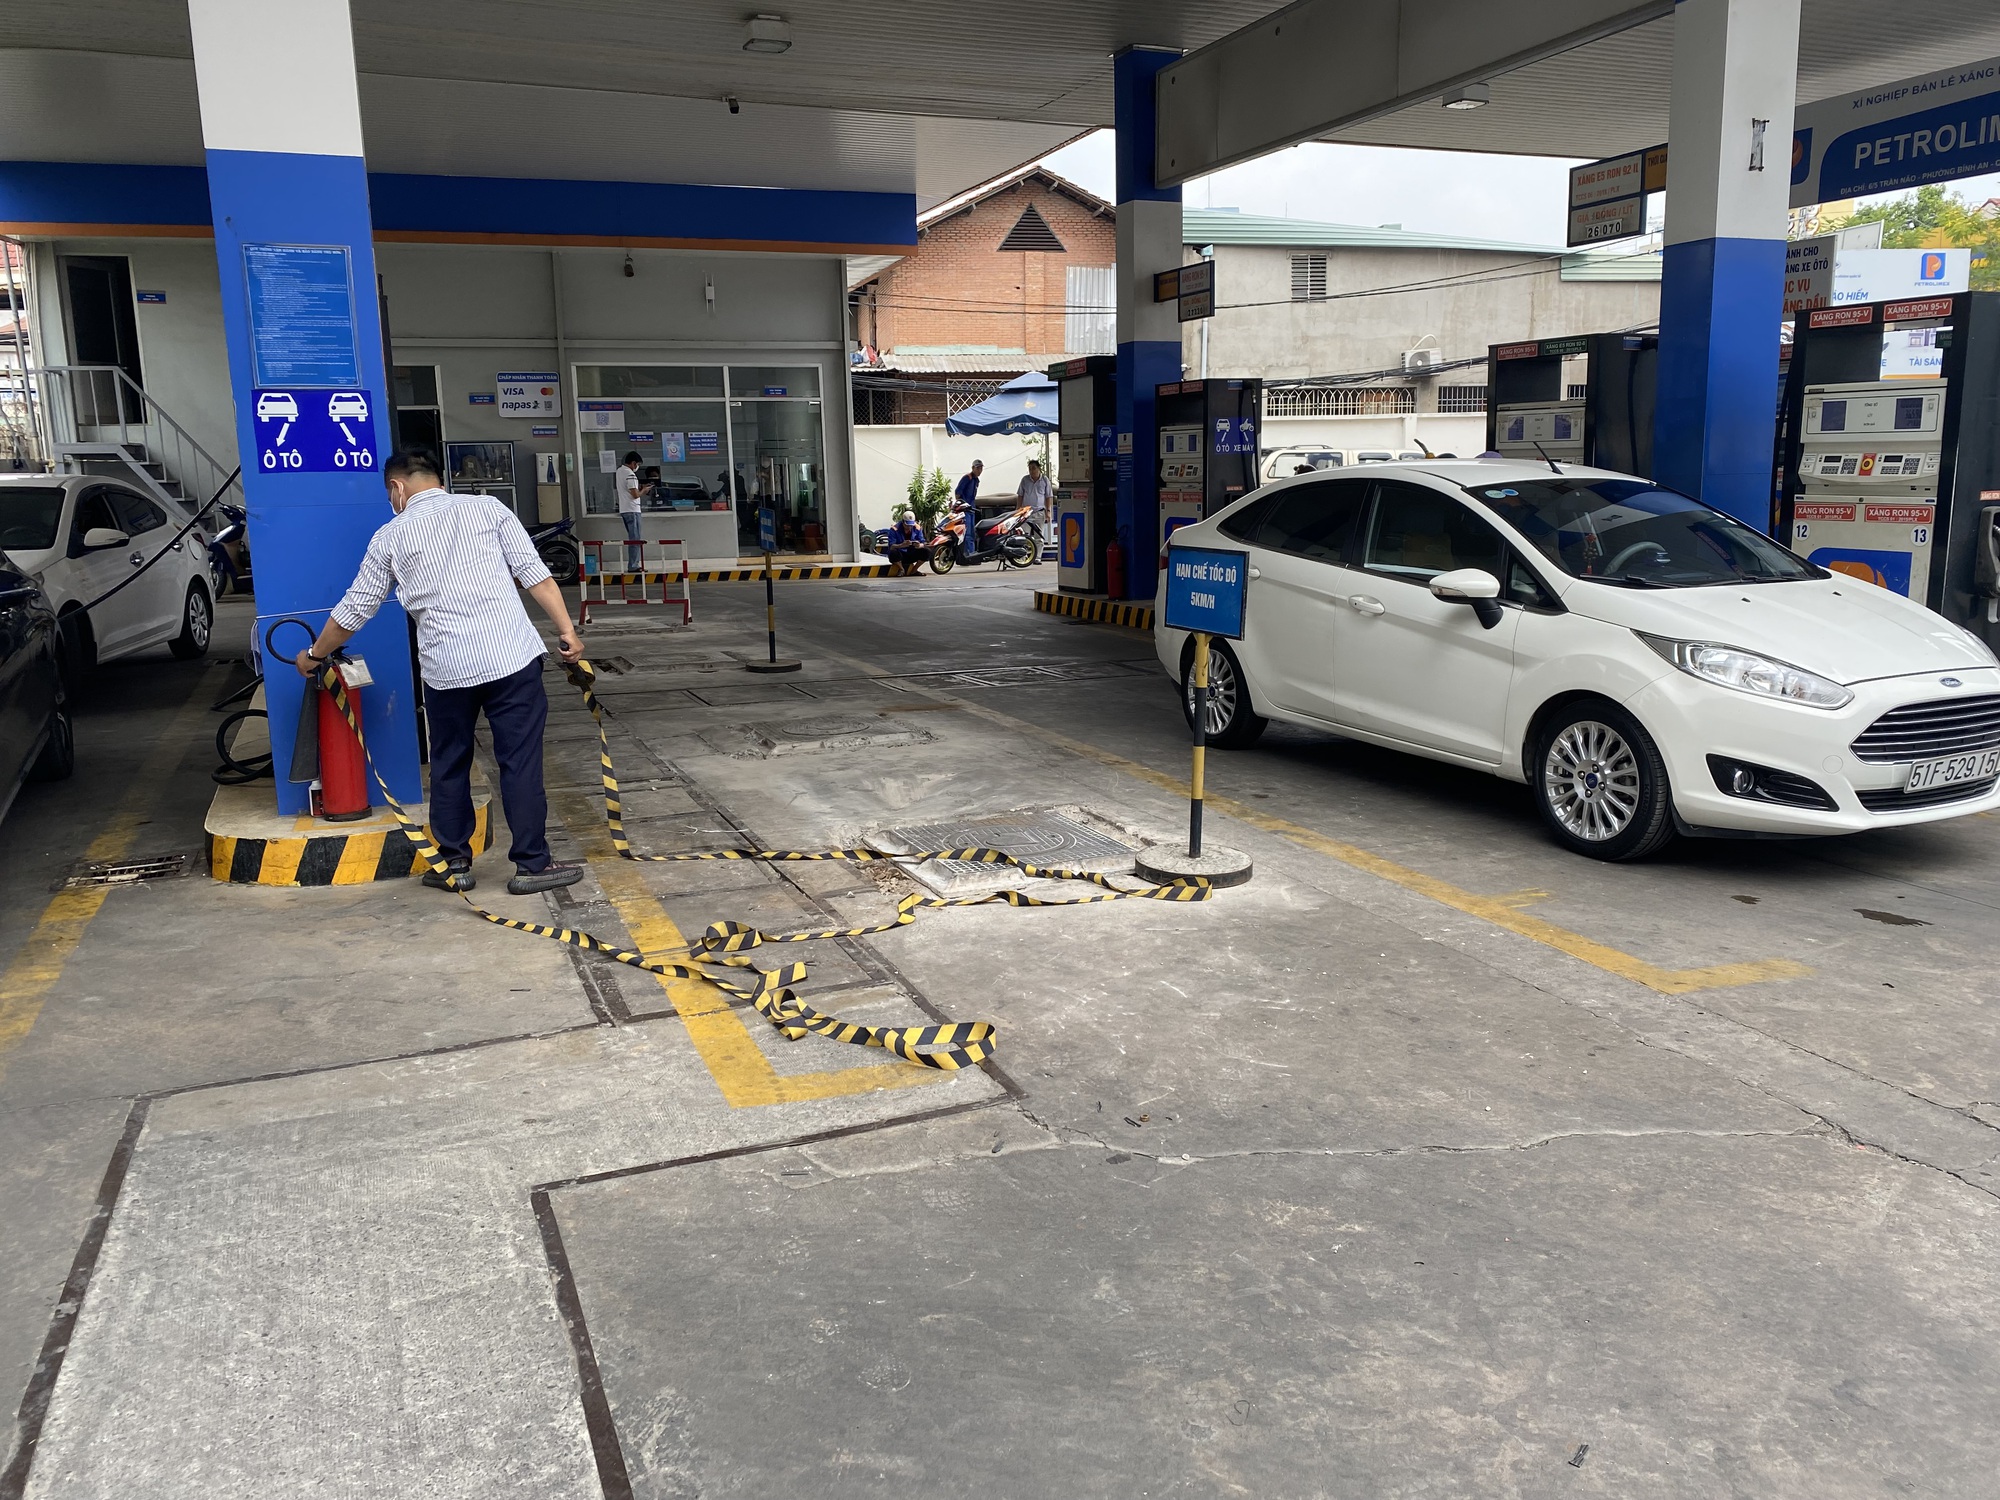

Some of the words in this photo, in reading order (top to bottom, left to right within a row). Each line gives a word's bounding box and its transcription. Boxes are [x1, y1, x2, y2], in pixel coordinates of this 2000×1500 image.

[1786, 248, 1801, 260] ÀNH
[1803, 246, 1819, 257] CHO
[1785, 262, 1800, 274] ÀNG
[1801, 262, 1811, 272] XE
[1797, 278, 1810, 294] VỤ
[1782, 298, 1803, 313] ĂNG
[1887, 305, 1910, 315] XĂNG
[1912, 303, 1929, 312] RON
[1931, 302, 1949, 311] 95-V
[1813, 312, 1834, 322] XĂNG
[1835, 311, 1851, 319] RON
[1852, 309, 1869, 318] 95-V
[502, 387, 524, 395] VISA
[1222, 444, 1230, 452] TÔ
[263, 449, 276, 469] Ô
[279, 448, 303, 468] TÔ
[334, 448, 347, 467] Ô
[350, 448, 373, 468] TÔ
[1798, 506, 1818, 514] XĂNG
[1869, 507, 1890, 516] XĂNG
[1911, 509, 1928, 517] 95-V
[1796, 525, 1808, 538] 12
[1914, 529, 1927, 543] 13
[1176, 563, 1191, 580] HẠN
[1192, 561, 1209, 580] CHẾ
[1209, 562, 1223, 582] TỐC
[1225, 565, 1236, 586] ĐỘ
[1191, 591, 1215, 609] 5KM/H
[1911, 752, 1998, 788] 51F-529.15
